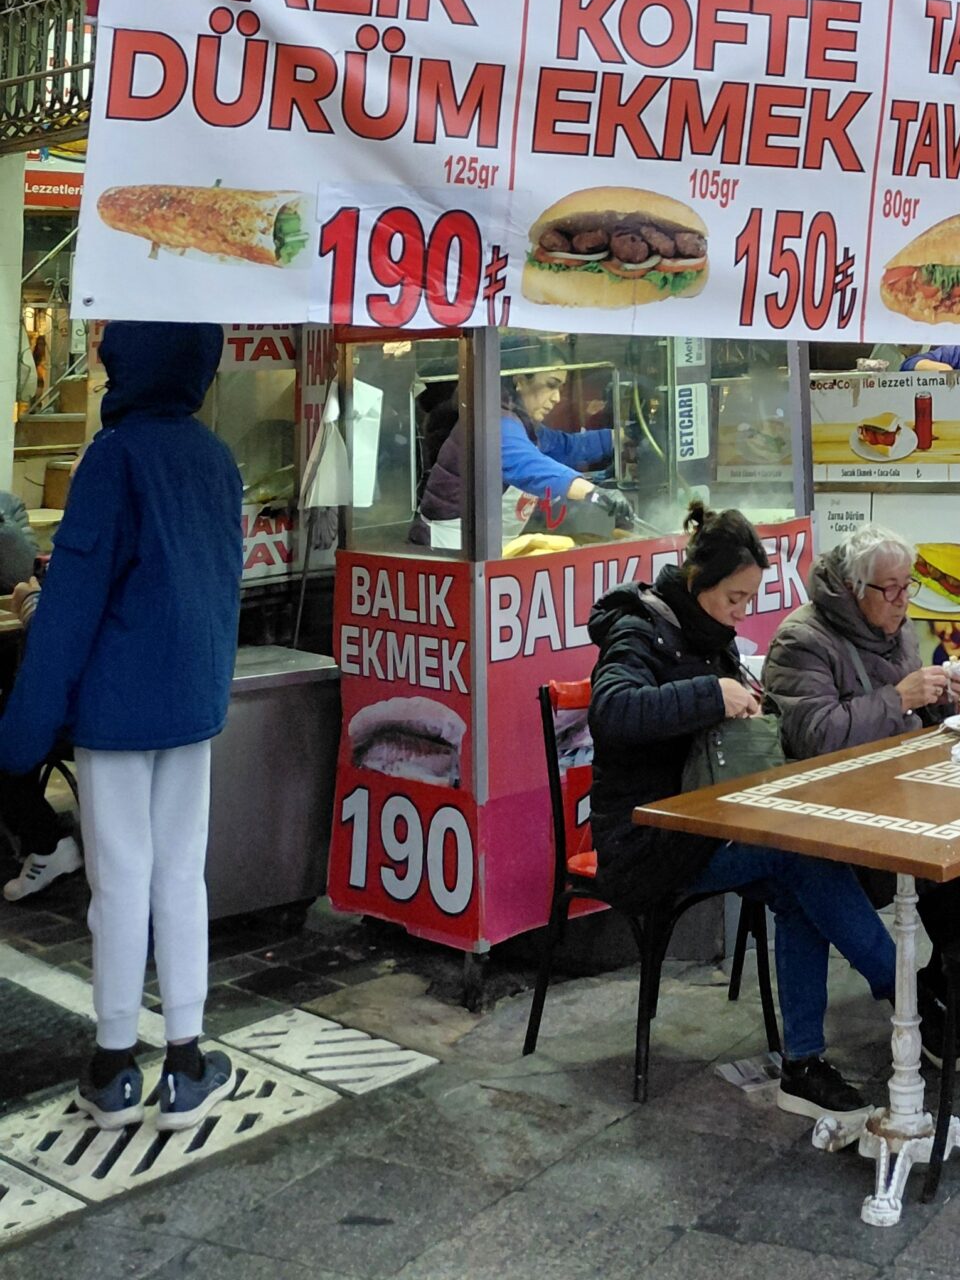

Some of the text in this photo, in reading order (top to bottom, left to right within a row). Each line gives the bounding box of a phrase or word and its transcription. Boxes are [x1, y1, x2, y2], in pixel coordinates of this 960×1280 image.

[105, 5, 506, 149] DÜRÜM
[531, 65, 873, 173] EKMEK
[443, 155, 499, 188] 125gr
[688, 167, 740, 208] 105gr
[880, 188, 921, 227] 80gr
[227, 336, 297, 361] TAV
[862, 378, 875, 389] ile
[878, 376, 913, 389] lezzeti
[678, 387, 694, 458] SETCARD
[350, 565, 455, 628] BALIK
[339, 624, 469, 695] EKMEK
[340, 786, 474, 916] 190
